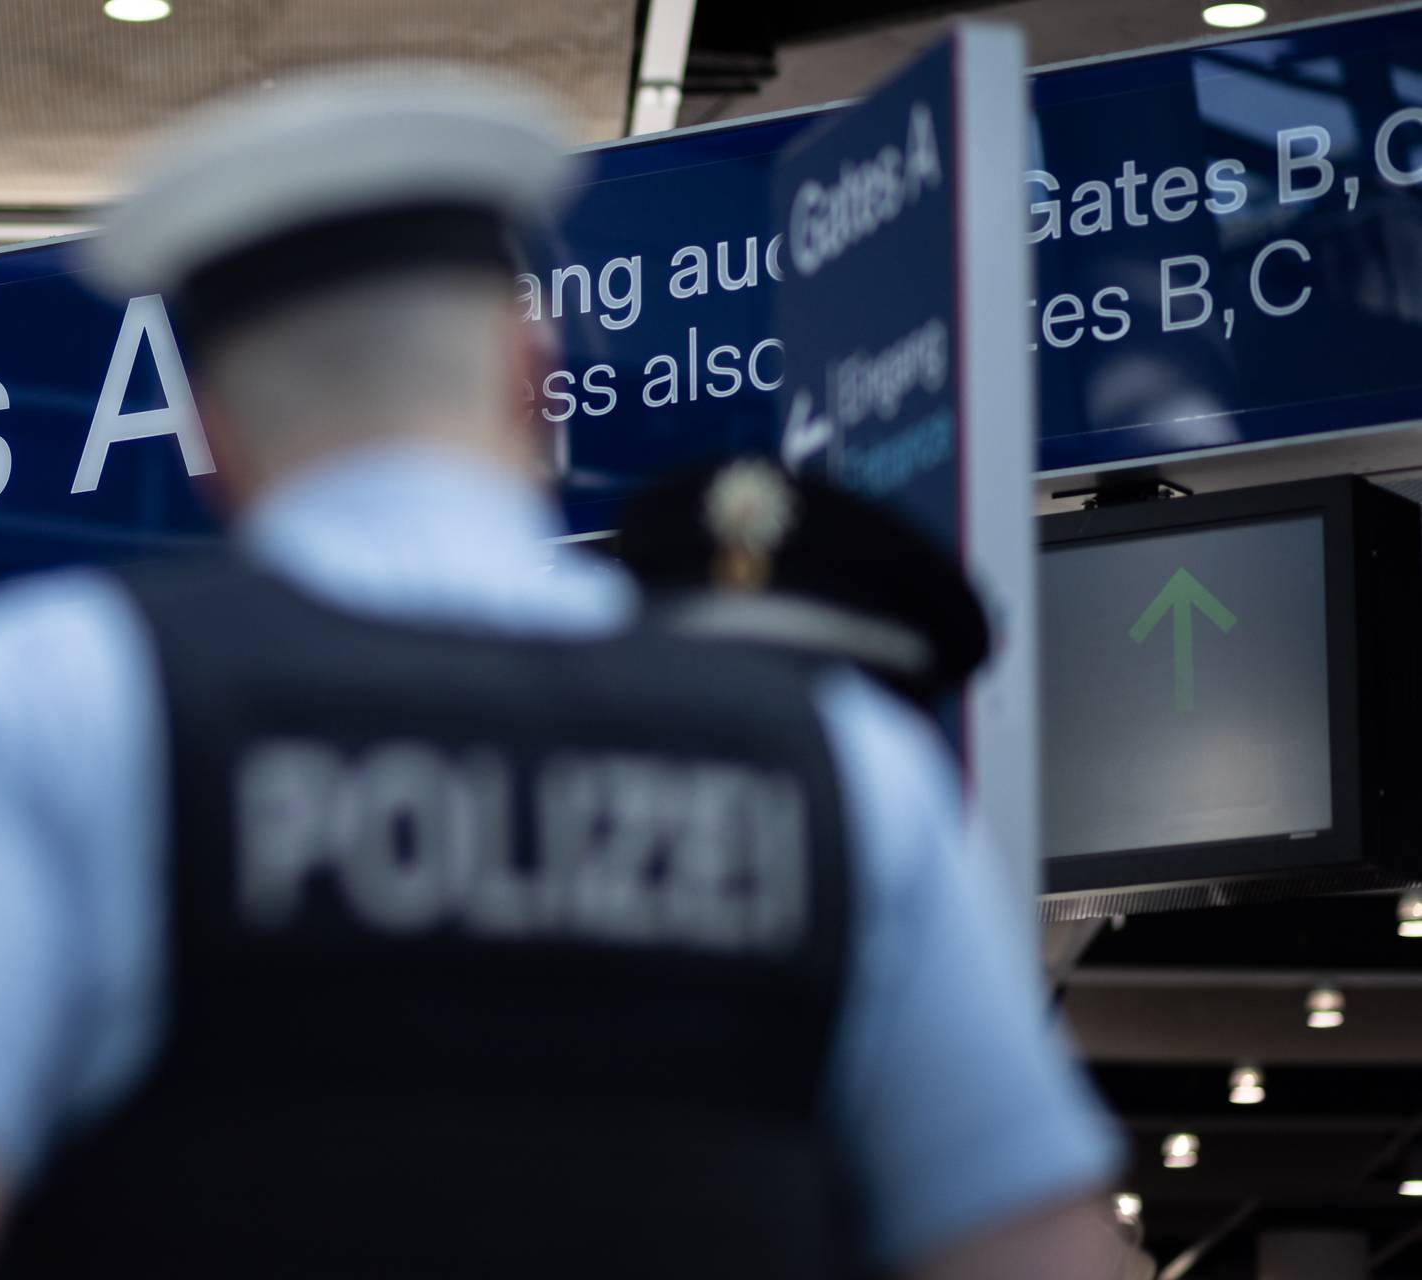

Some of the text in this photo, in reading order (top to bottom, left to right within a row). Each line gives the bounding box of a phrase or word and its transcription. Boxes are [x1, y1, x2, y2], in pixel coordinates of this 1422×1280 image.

[789, 102, 942, 275] Gates A
[1024, 160, 1248, 245] Gates
[71, 293, 218, 495] A
[641, 327, 785, 408] also
[236, 738, 808, 952] POLIZEI
